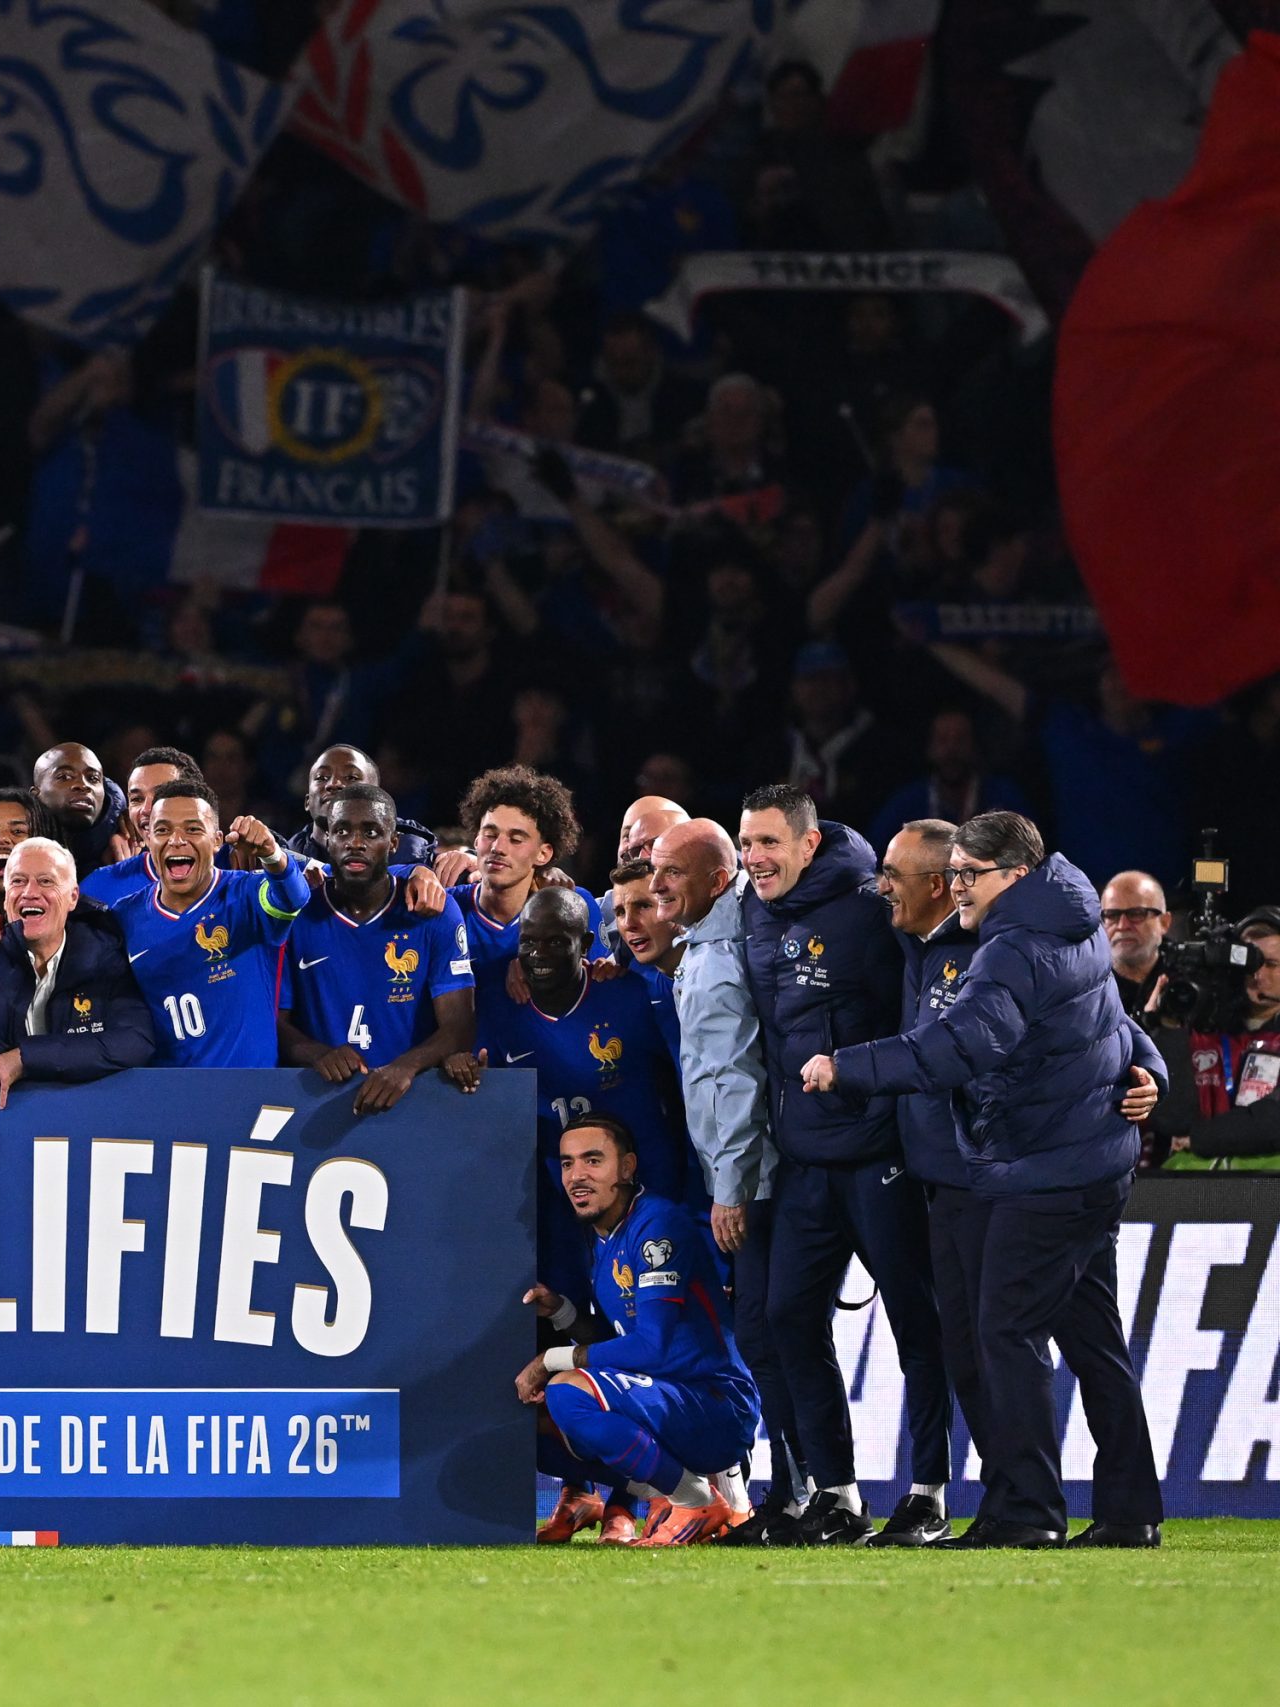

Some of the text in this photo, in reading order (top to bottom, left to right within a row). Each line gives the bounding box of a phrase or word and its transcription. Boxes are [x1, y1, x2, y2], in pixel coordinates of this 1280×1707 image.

[292, 377, 364, 439] IF
[163, 992, 206, 1041] 10
[347, 1004, 372, 1050] 4
[61, 1415, 108, 1474] DE
[127, 1415, 169, 1475] LA
[188, 1415, 271, 1474] FIFA
